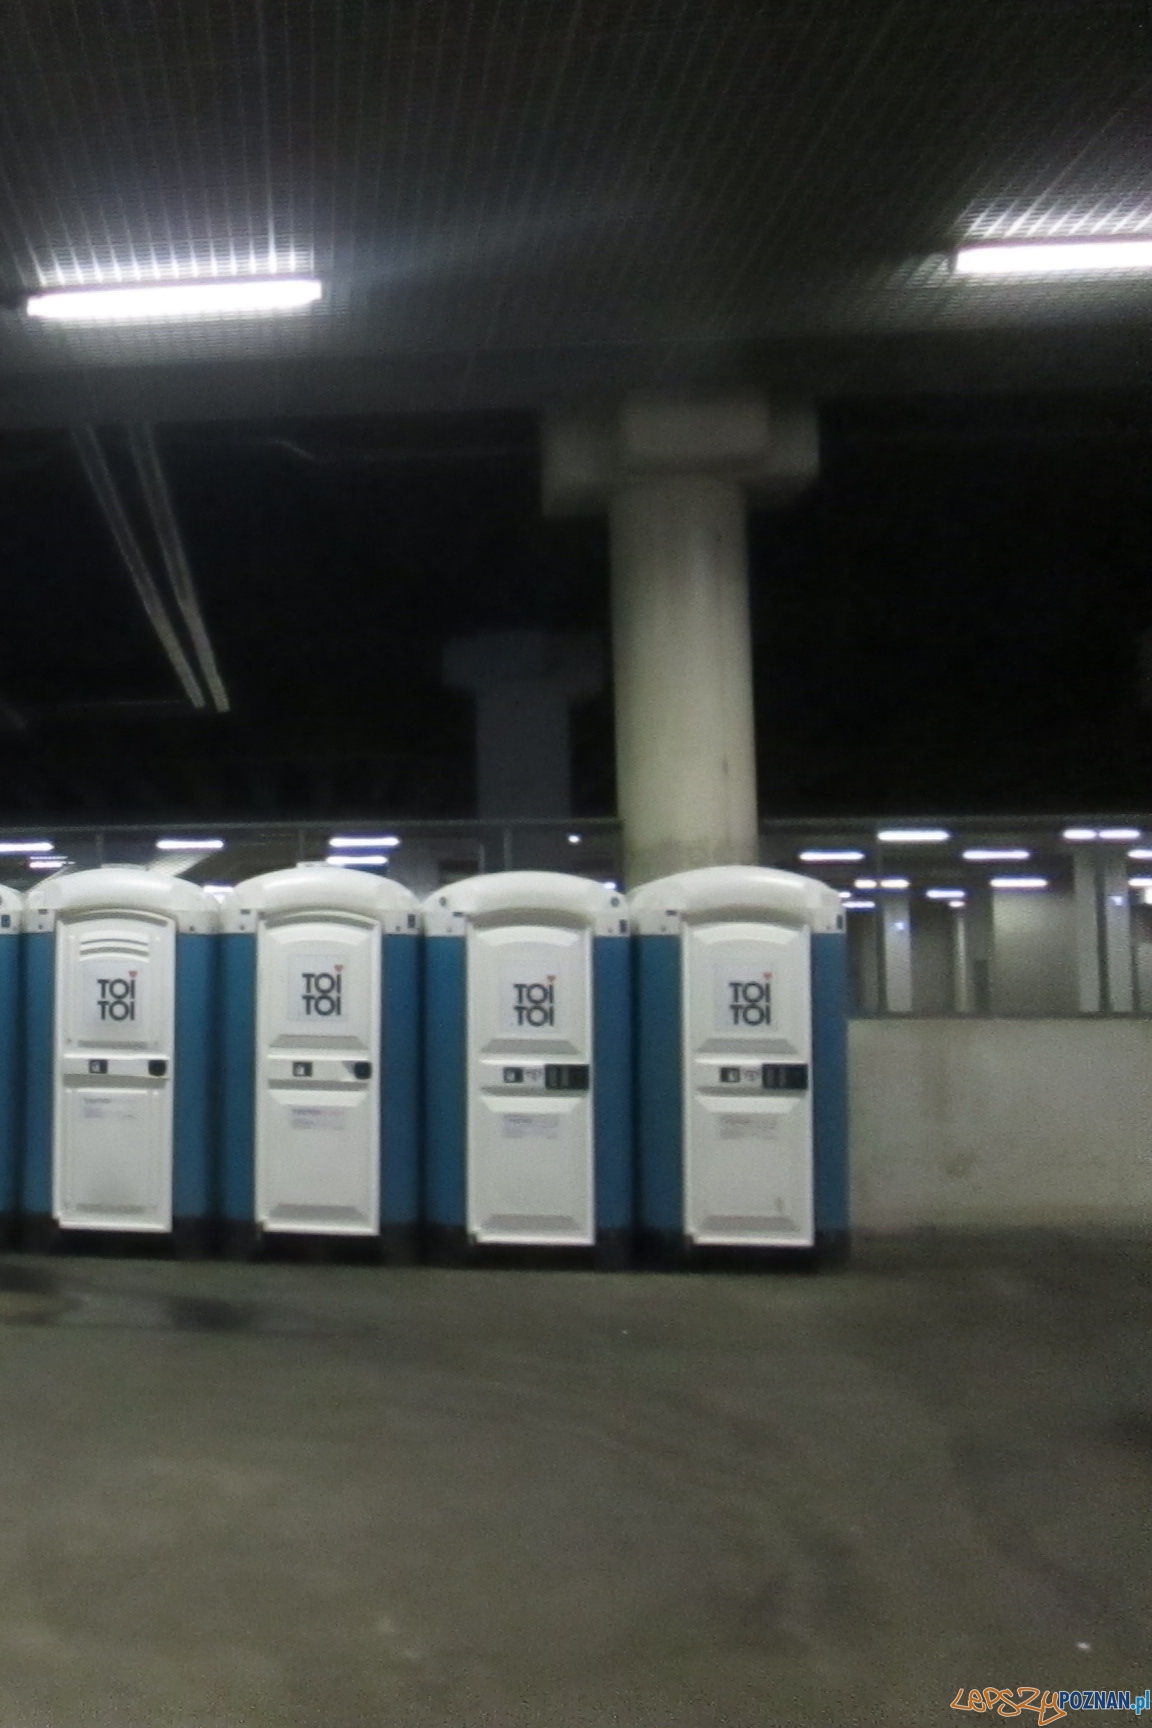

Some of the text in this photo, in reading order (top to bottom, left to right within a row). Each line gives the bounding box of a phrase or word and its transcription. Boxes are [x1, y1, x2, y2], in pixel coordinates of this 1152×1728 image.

[97, 1000, 136, 1021] TOI
[303, 994, 342, 1016] TOI
[514, 1004, 555, 1027] TOI
[730, 1003, 772, 1026] TOI
